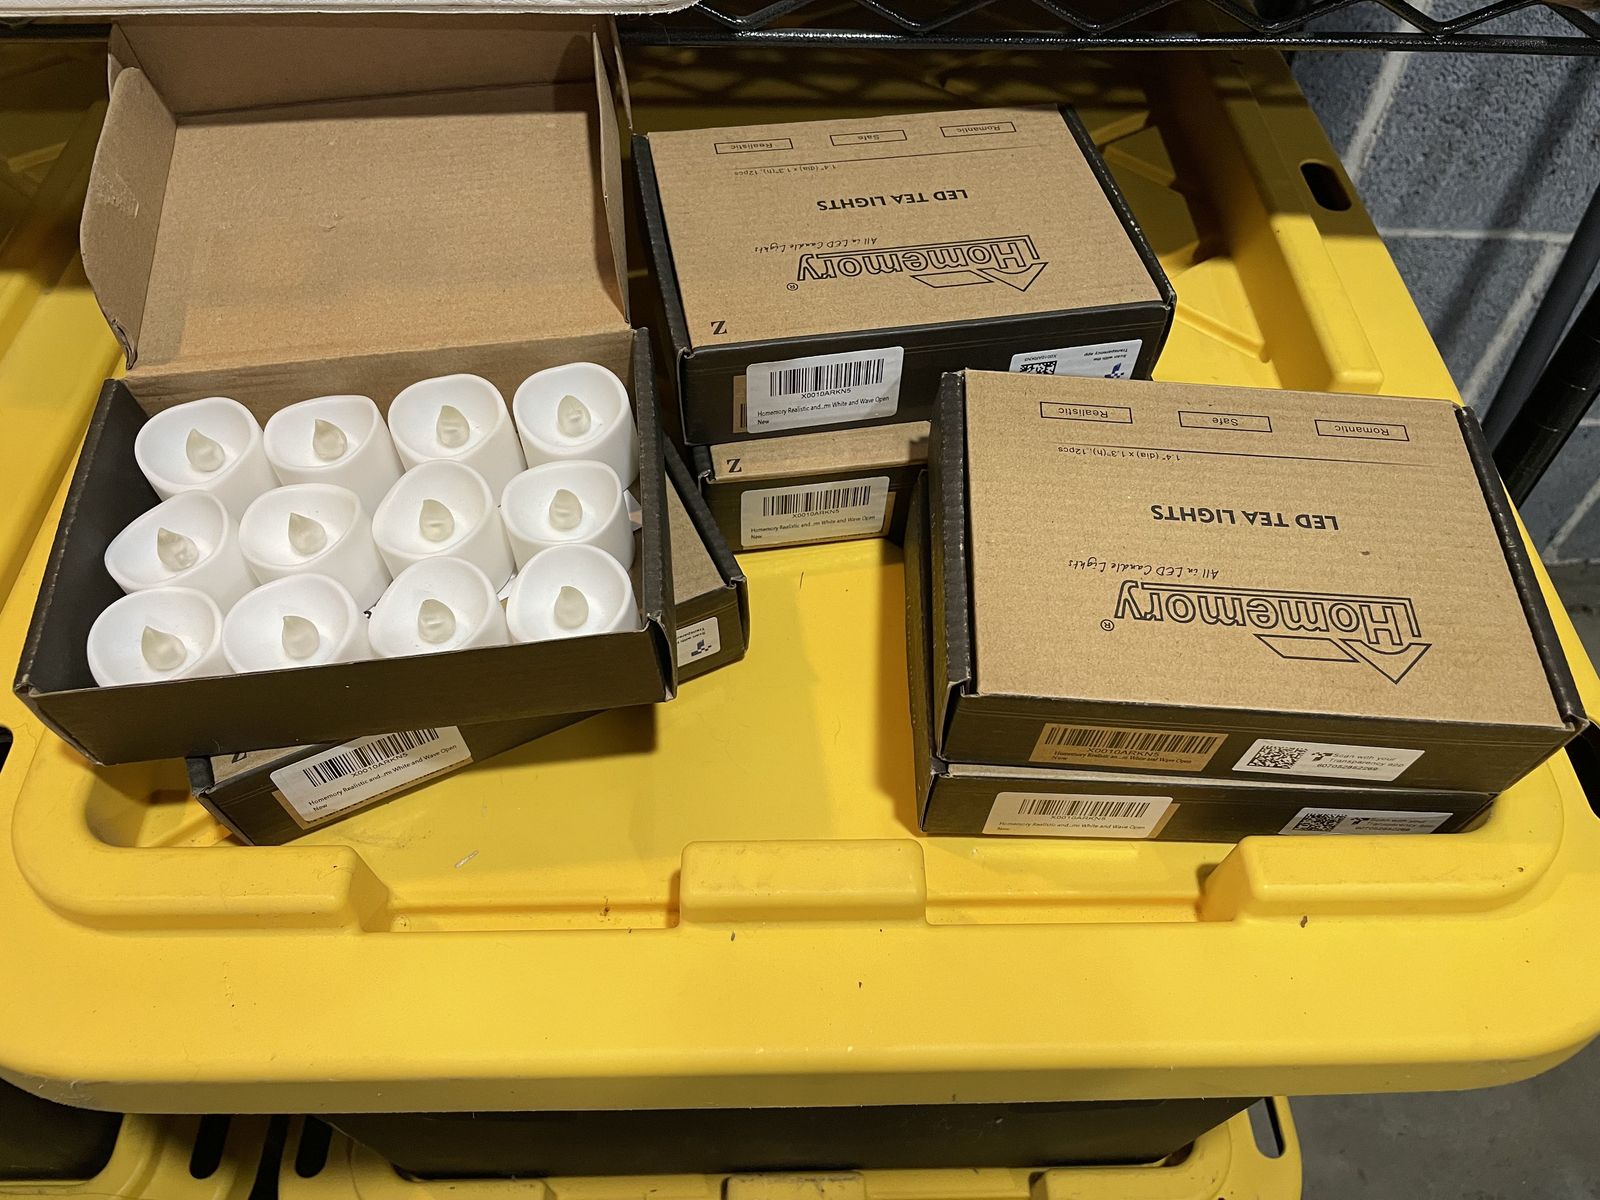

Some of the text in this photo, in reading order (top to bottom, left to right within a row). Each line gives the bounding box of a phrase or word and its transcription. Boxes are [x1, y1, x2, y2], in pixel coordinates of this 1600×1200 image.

[956, 125, 1001, 133] Romantic
[730, 142, 773, 151] Realistic
[817, 189, 969, 211] LED TEA LIGHTS
[790, 241, 823, 251] Candle
[827, 240, 848, 248] LED
[864, 237, 878, 245] All
[754, 242, 786, 254] Lights
[797, 241, 1027, 282] Homemory
[801, 388, 852, 399] X0010ARKN5
[757, 407, 787, 417] Homemory
[788, 405, 810, 413] Realistic
[832, 400, 847, 408] White
[875, 395, 890, 403] Open
[1058, 406, 1109, 419] Realistic
[1212, 416, 1239, 427] Safe
[1334, 424, 1390, 437] Romantic
[1057, 446, 1086, 455] 12pcs
[1136, 451, 1159, 460] (dia)
[792, 509, 840, 519] X0010ARKN5
[1150, 504, 1340, 531] LED TEA LIGHTS
[1068, 556, 1219, 579] All in LED Candle Lights
[1113, 579, 1404, 646] Homemory
[1088, 747, 1160, 757] X0010ARKN5
[351, 752, 408, 778] X0010ARKN5
[309, 789, 343, 807] Homemory
[343, 778, 369, 793] Realistic
[392, 761, 411, 774] White
[411, 756, 424, 767] and
[424, 750, 441, 762] Wave
[441, 744, 457, 754] Open
[313, 803, 328, 812] New
